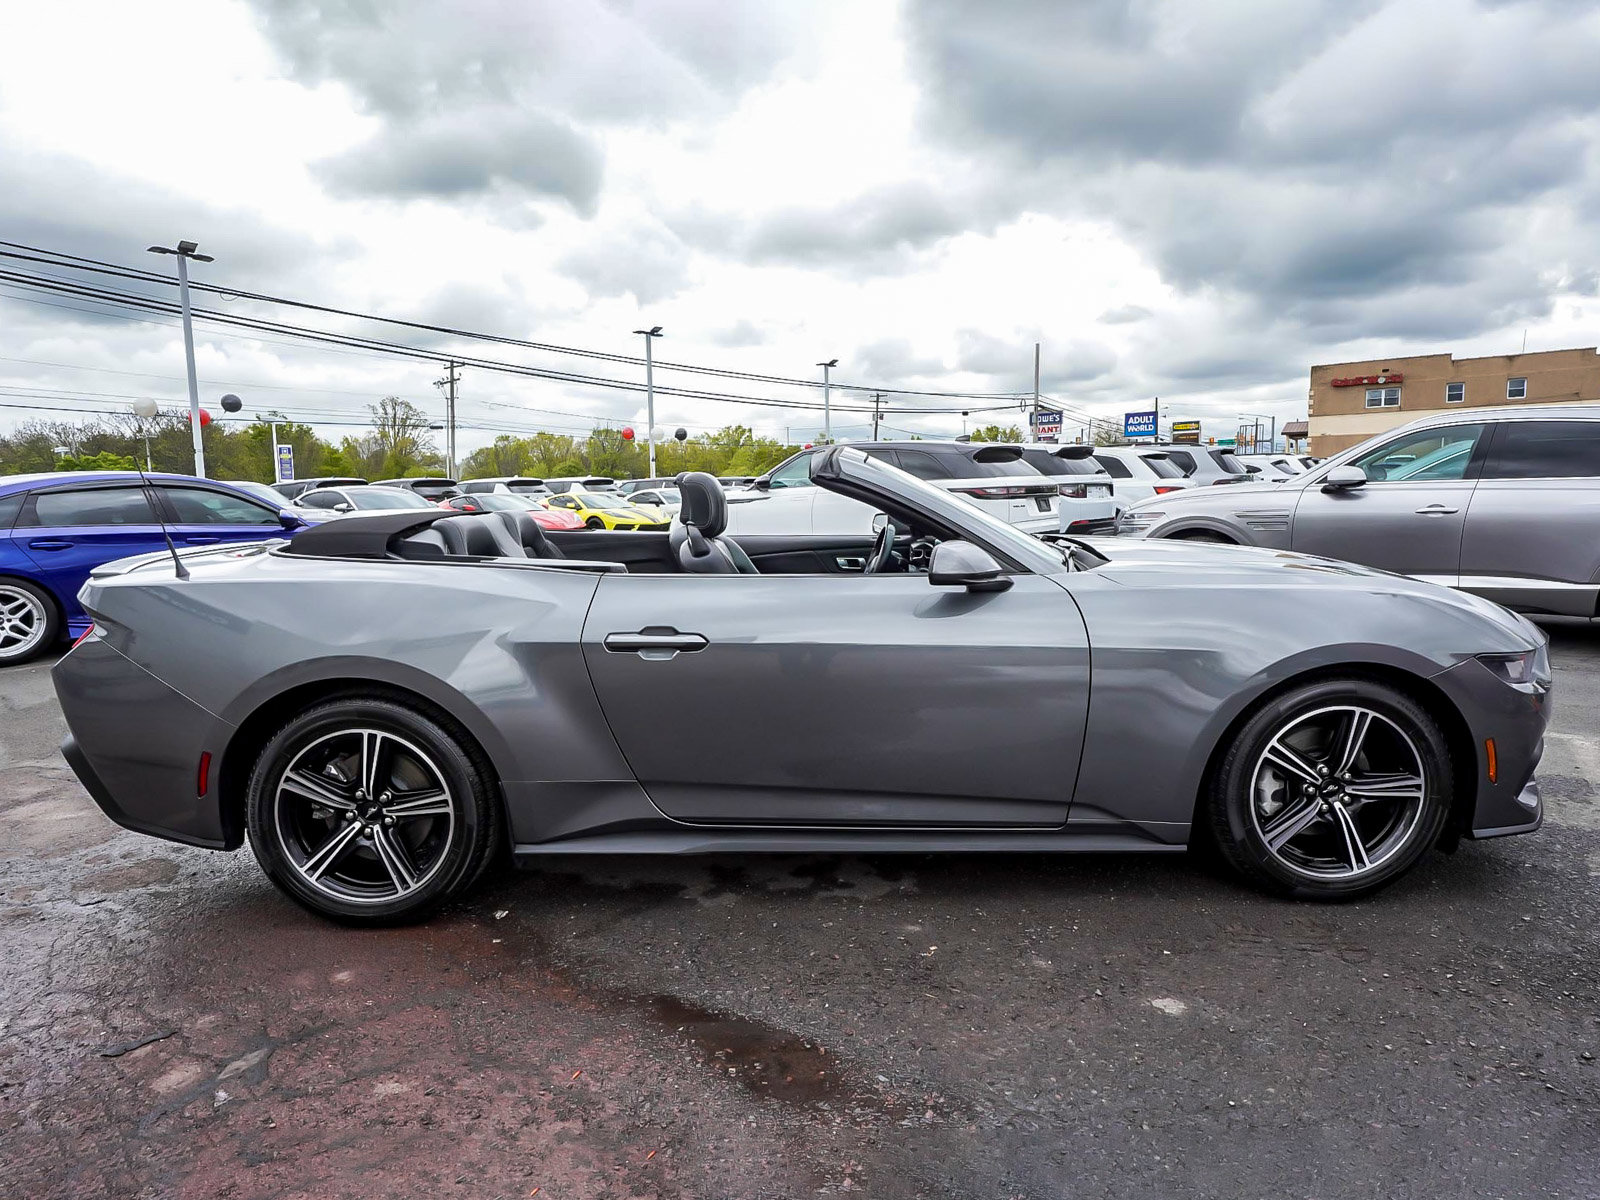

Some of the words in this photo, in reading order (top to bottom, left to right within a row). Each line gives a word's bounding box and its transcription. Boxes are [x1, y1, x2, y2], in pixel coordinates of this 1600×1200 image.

[1032, 413, 1060, 422] OWE'S
[1128, 415, 1154, 424] ADULT
[1031, 426, 1059, 434] IANT
[1127, 424, 1154, 433] WORLD
